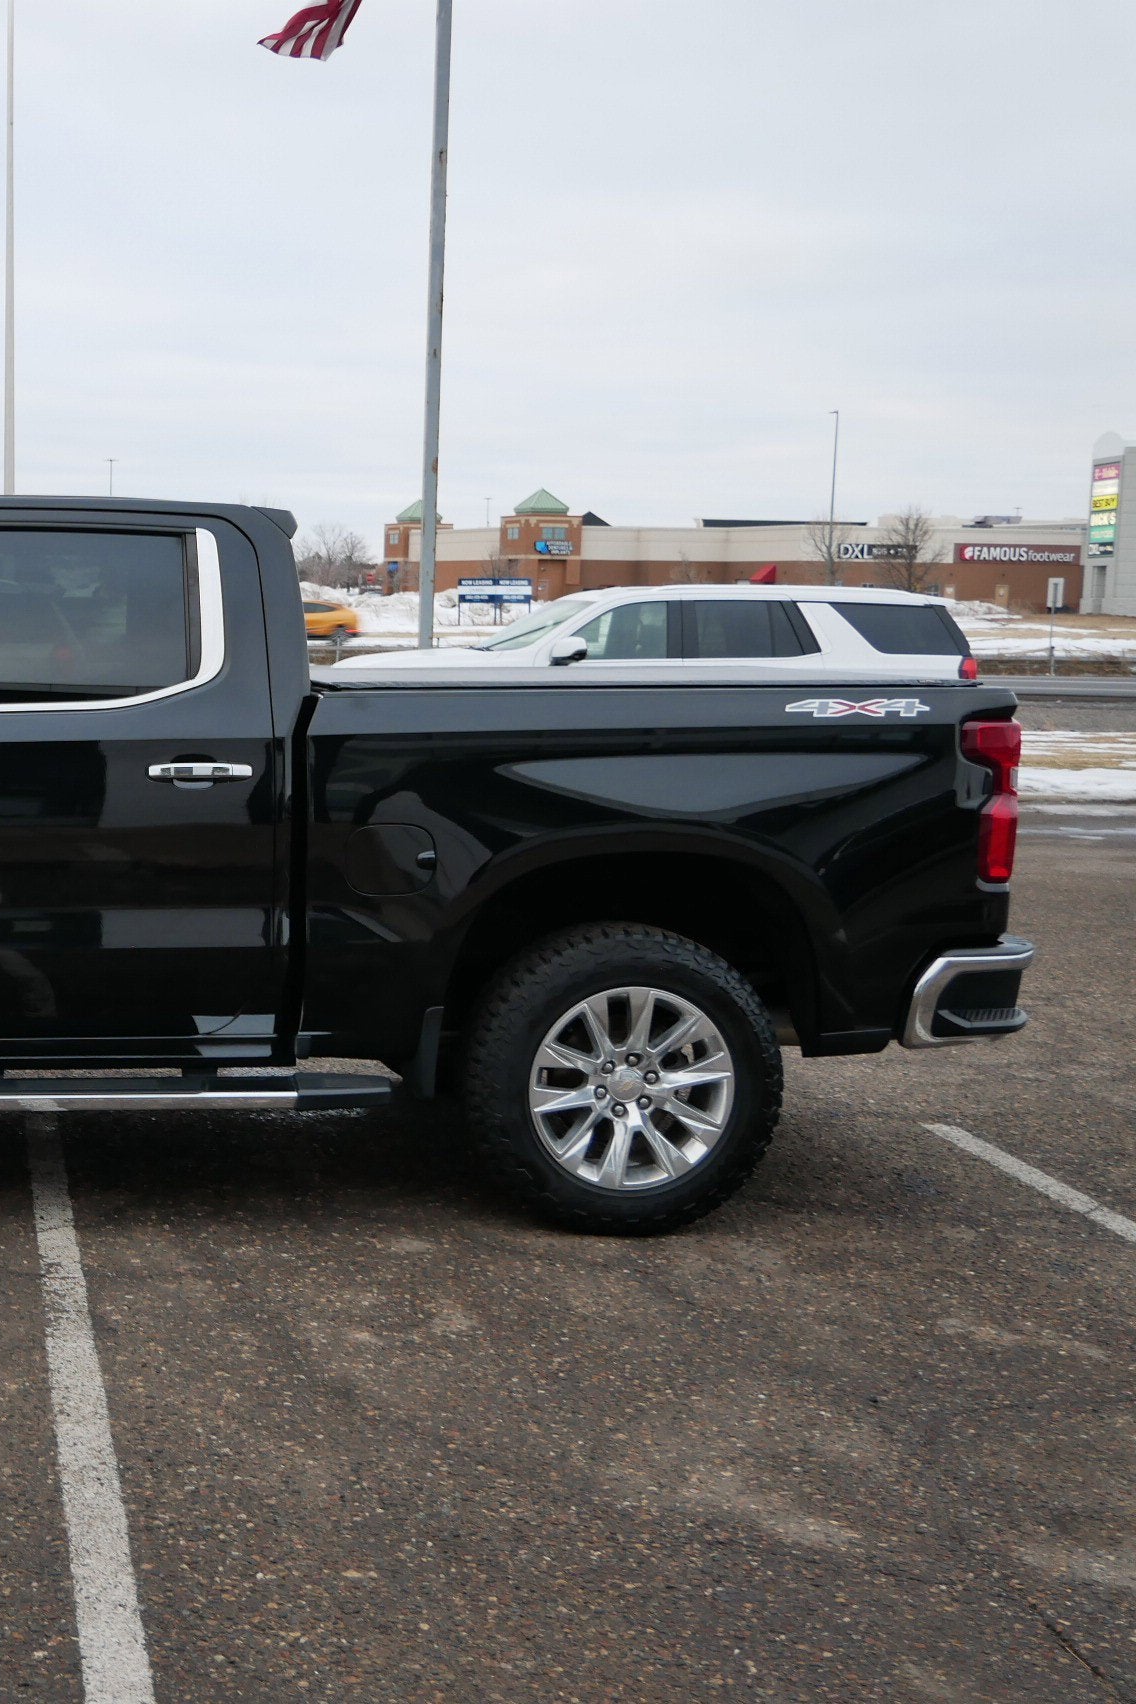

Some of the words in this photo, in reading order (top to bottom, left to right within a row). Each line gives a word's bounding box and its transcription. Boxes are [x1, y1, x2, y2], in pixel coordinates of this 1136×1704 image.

[839, 543, 873, 559] DXL
[974, 546, 1028, 561] FAMOUS
[1028, 550, 1075, 562] footwear
